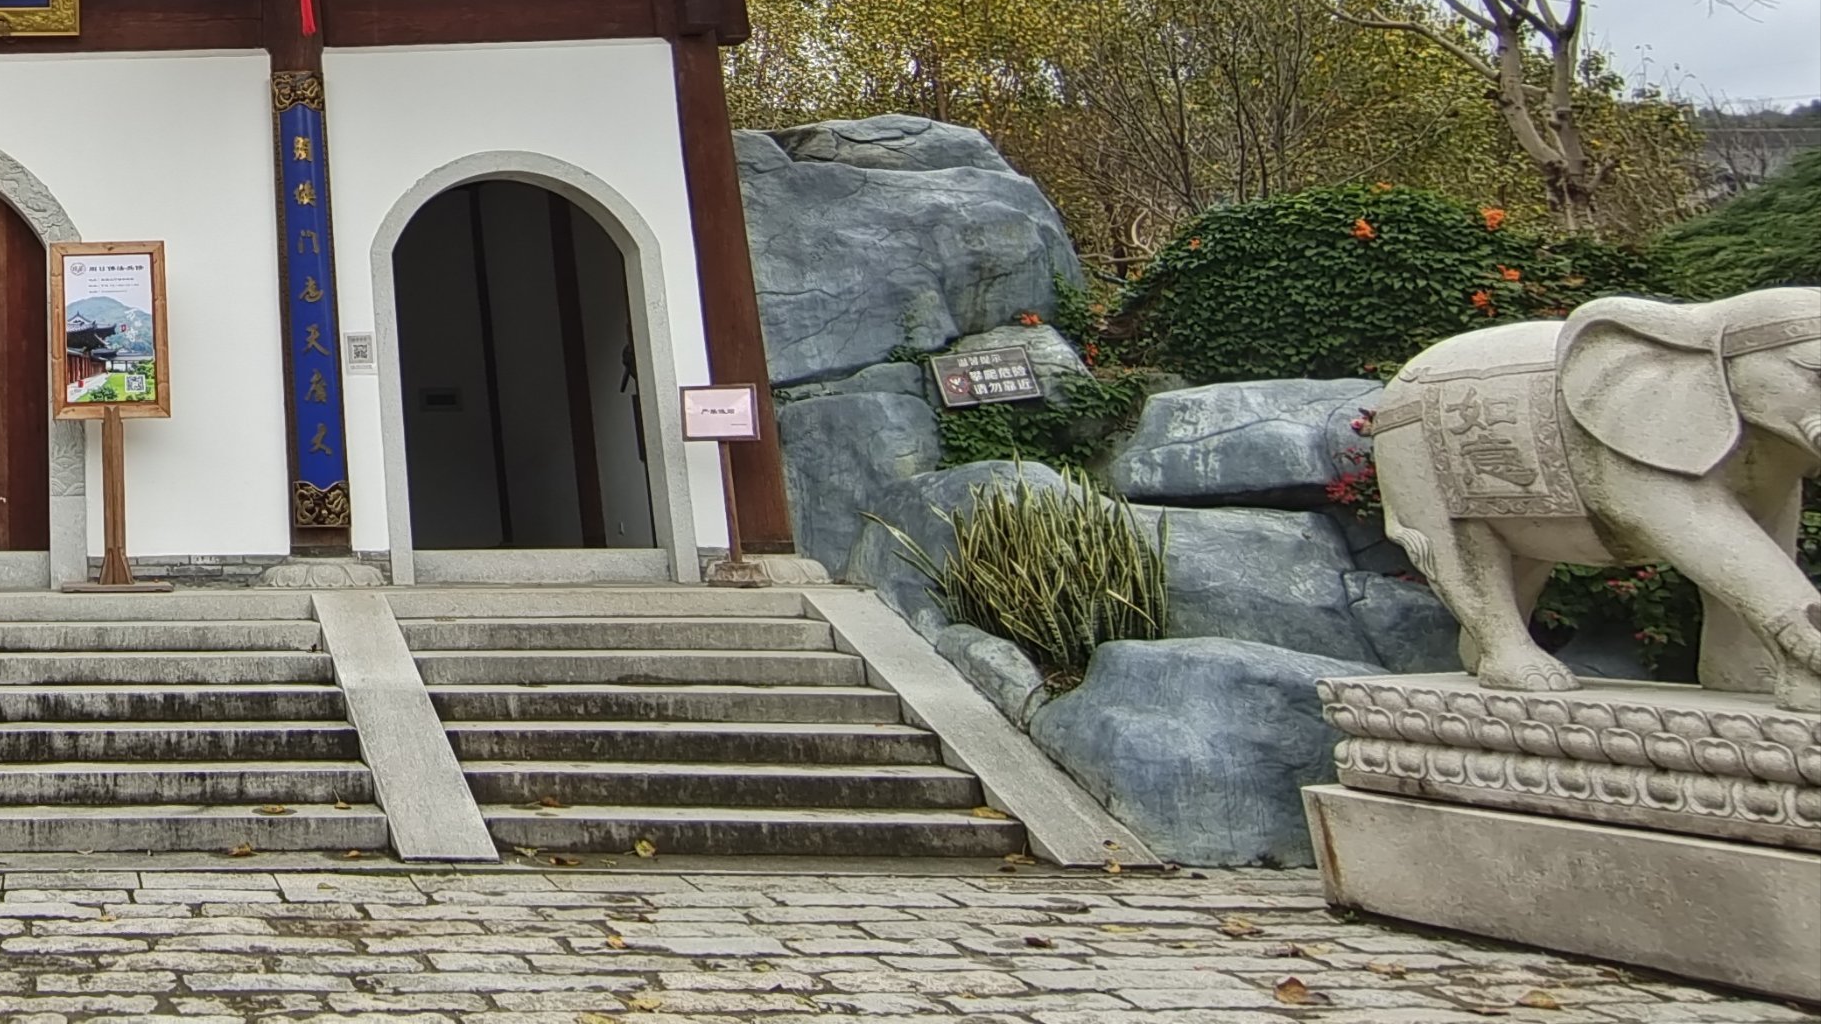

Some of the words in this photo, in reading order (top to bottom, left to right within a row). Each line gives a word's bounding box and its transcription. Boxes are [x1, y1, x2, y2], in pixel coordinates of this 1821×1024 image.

[969, 366, 1027, 382] 攀爬危险
[973, 378, 1033, 394] 请勿靠近
